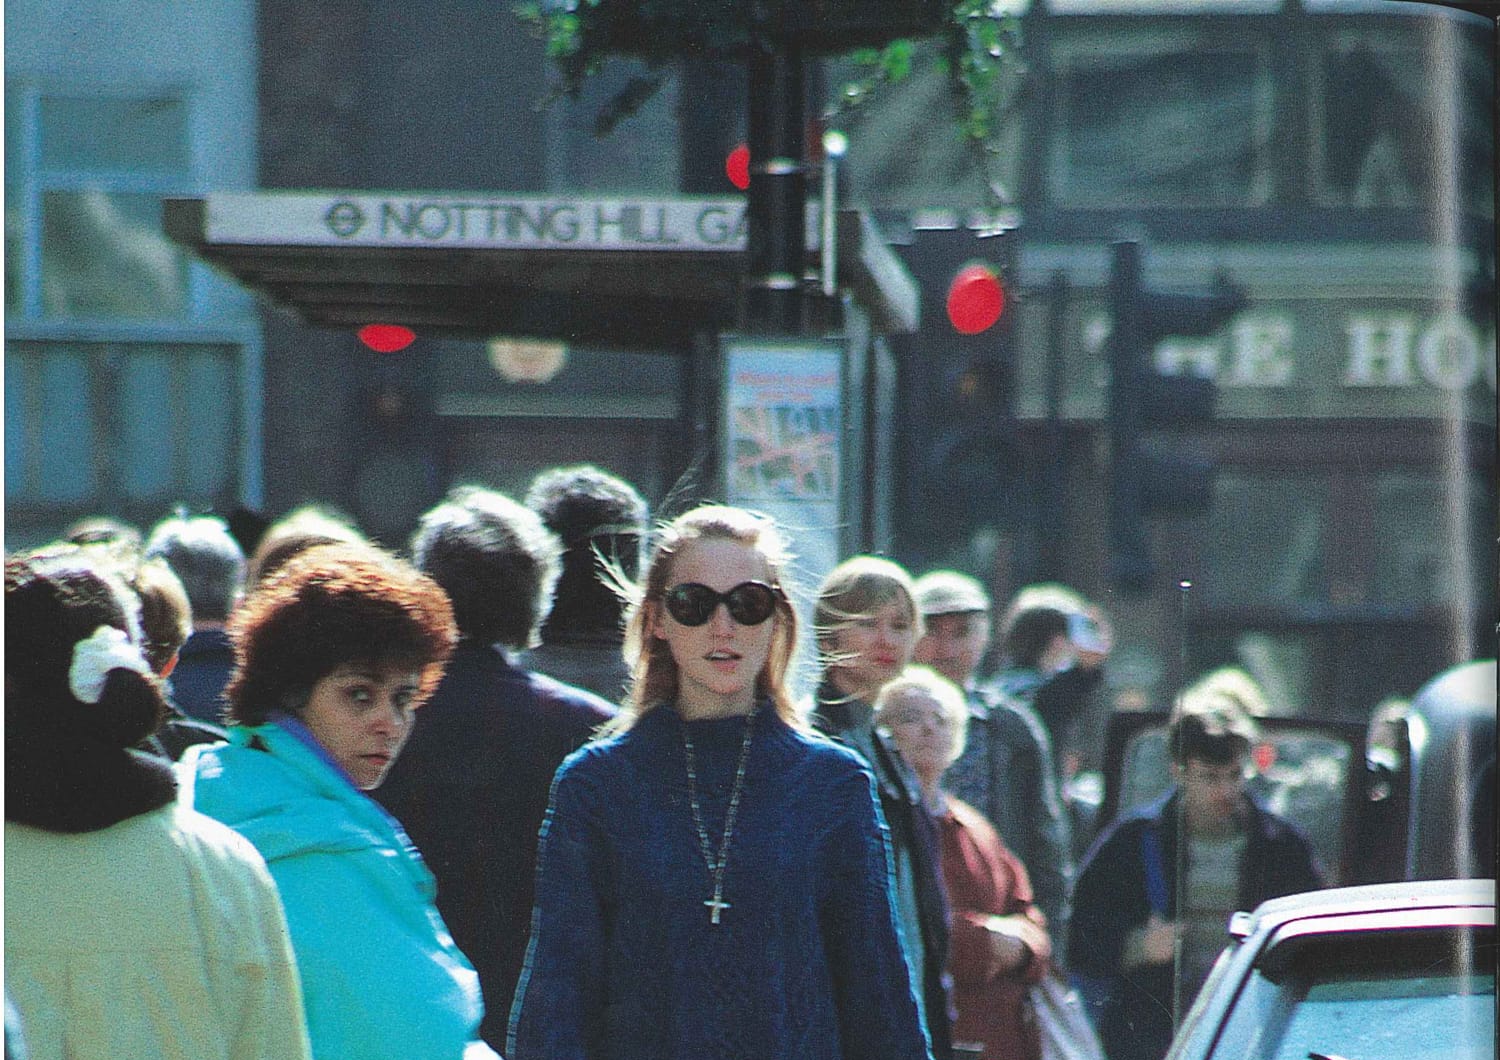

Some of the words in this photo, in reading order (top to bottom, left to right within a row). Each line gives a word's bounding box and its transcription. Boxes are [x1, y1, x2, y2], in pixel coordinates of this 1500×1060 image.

[381, 203, 580, 242] NOTTING
[594, 205, 679, 243] HILL
[1344, 312, 1496, 390] HO
